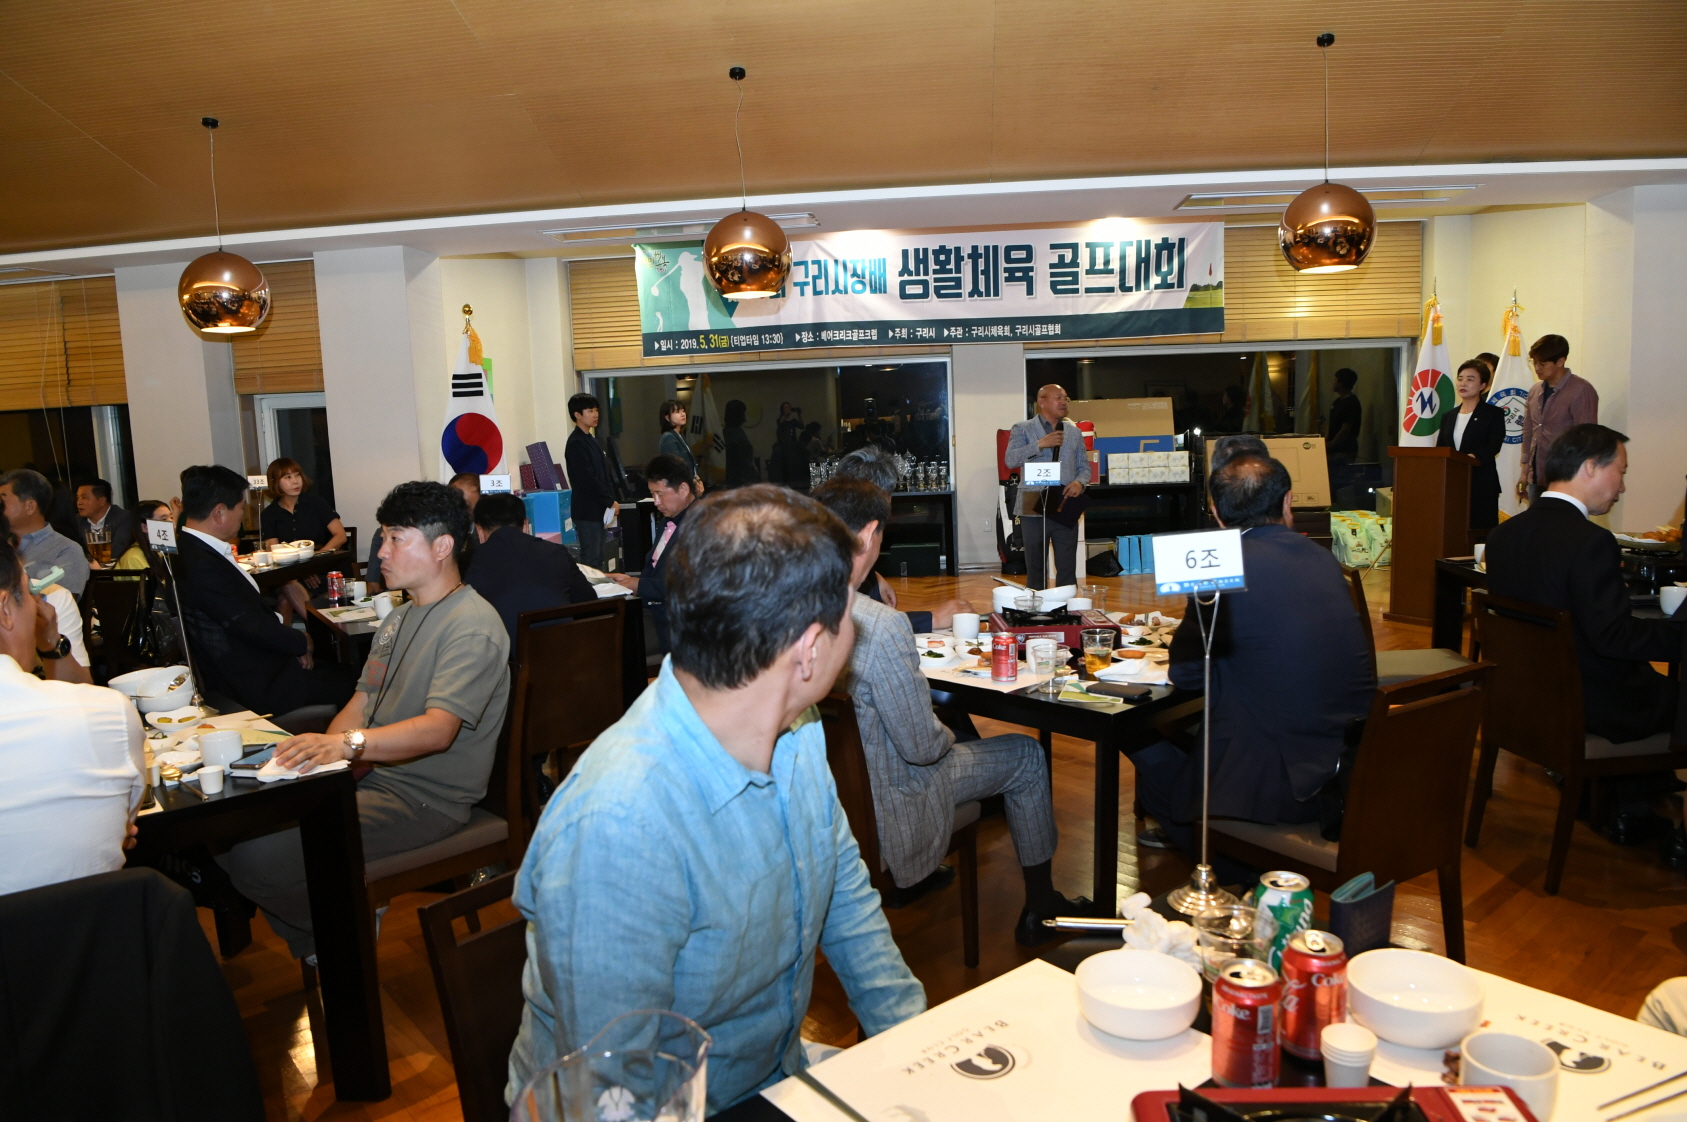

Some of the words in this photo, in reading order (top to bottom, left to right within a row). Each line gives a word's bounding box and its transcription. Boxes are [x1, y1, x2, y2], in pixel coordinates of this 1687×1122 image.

[793, 257, 888, 296] 구리시장배
[898, 244, 1035, 301] 생활체육
[1049, 236, 1186, 295] 골프대회
[801, 331, 815, 343] 장소
[894, 327, 908, 339] 주최
[915, 327, 936, 339] 구리시
[949, 326, 963, 338] 주관
[1015, 323, 1062, 336] 구리시골프협회
[660, 340, 673, 351] 일시
[708, 333, 730, 349] 31(금)
[1036, 468, 1052, 477] 2조
[490, 479, 503, 487] 3조
[156, 528, 169, 541] 4조
[1185, 548, 1221, 569] 6조
[992, 642, 1007, 650] Coke
[1310, 972, 1344, 987] Cok
